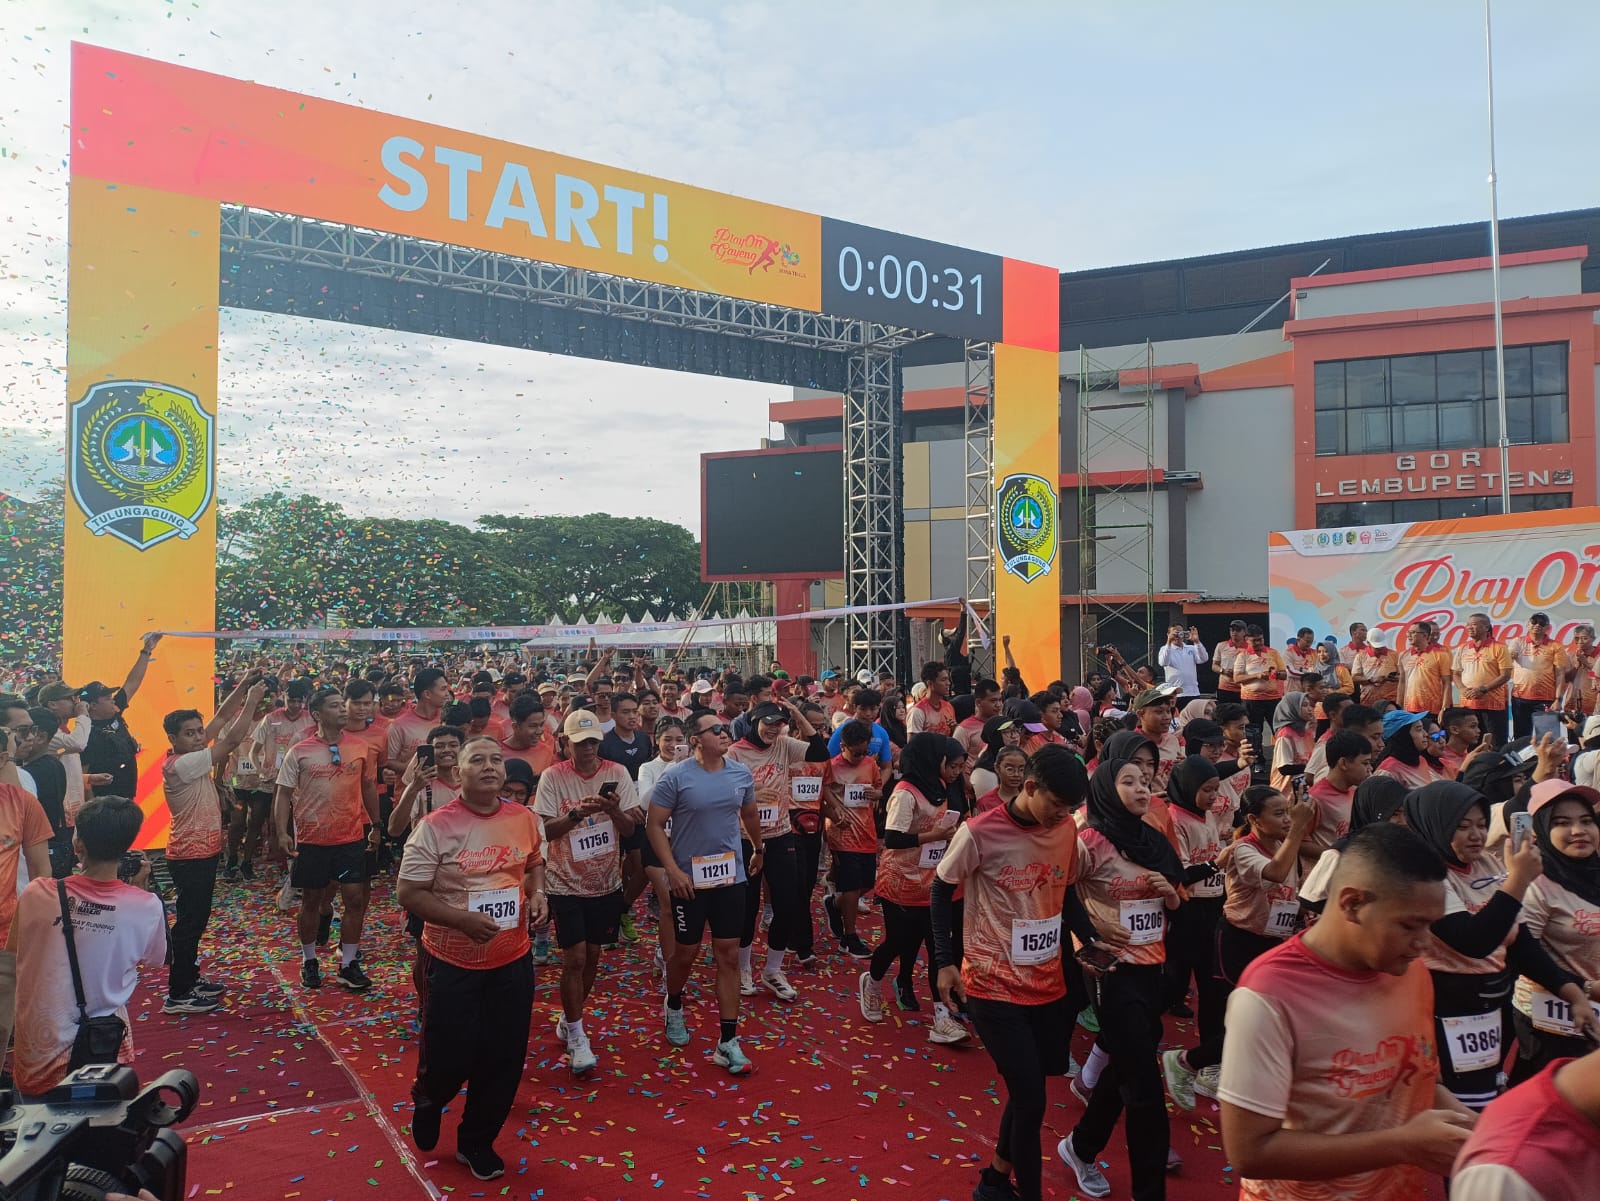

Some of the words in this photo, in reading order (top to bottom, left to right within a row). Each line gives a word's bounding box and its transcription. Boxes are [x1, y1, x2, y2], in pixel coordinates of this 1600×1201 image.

[377, 136, 668, 263] START!
[839, 246, 982, 315] 0:00:31
[91, 507, 185, 528] TULUNGAGUNG
[797, 784, 819, 793] 13284
[578, 832, 609, 850] 11756
[702, 863, 728, 878] 11211
[478, 901, 515, 918] 15378
[1128, 911, 1162, 931] 15206
[1021, 928, 1058, 951] 15264
[1457, 1026, 1500, 1054] 13864
